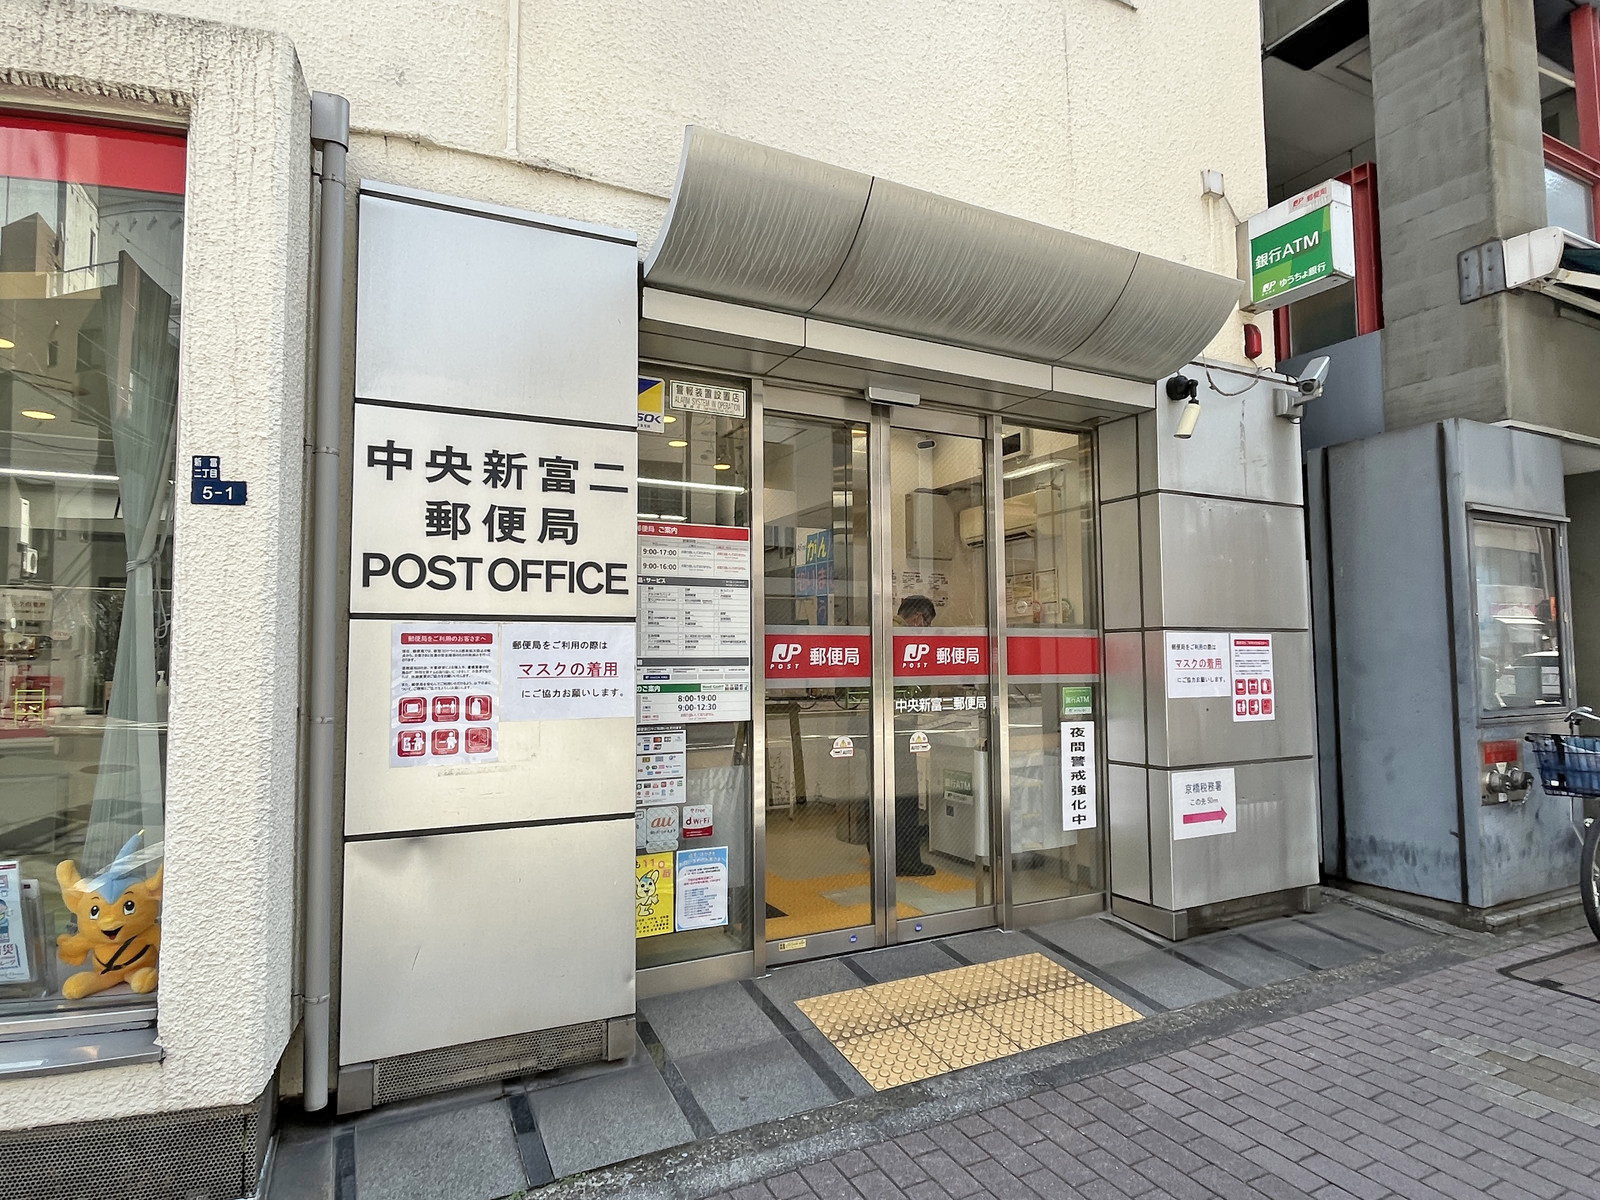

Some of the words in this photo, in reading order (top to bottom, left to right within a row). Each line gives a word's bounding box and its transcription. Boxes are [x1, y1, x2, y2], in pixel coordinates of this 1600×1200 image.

[1255, 230, 1319, 270] 銀行ATM
[1279, 262, 1327, 288] ゆうちょ銀行
[691, 398, 710, 407] SYSTEM
[194, 468, 218, 478] 二丁目
[367, 439, 629, 495] 中央新富二
[202, 486, 232, 500] 5-1
[425, 500, 579, 546] 郵便局
[658, 526, 678, 535] ご案内
[642, 548, 677, 556] 9:00-17:00
[642, 562, 677, 570] 9:00-16:00
[362, 552, 483, 591] POST
[488, 557, 629, 595] OFFICE
[512, 640, 608, 650] 郵便局をご利用の際は
[772, 644, 802, 662] JP
[809, 647, 860, 666] 郵便局
[903, 644, 930, 662] JP
[936, 647, 980, 664] 郵便局
[519, 662, 618, 677] マスクの着用
[1175, 658, 1222, 669] マスクの着用
[521, 688, 624, 699] にご協力お願いします。
[677, 694, 717, 702] 8:00-19:00
[677, 703, 717, 711] 9:00-12:30
[895, 696, 987, 714] 中央新富二郵便局
[1069, 727, 1087, 825] 夜間警戒強化中
[1185, 781, 1222, 795] 京橋税務署
[650, 816, 675, 829] au
